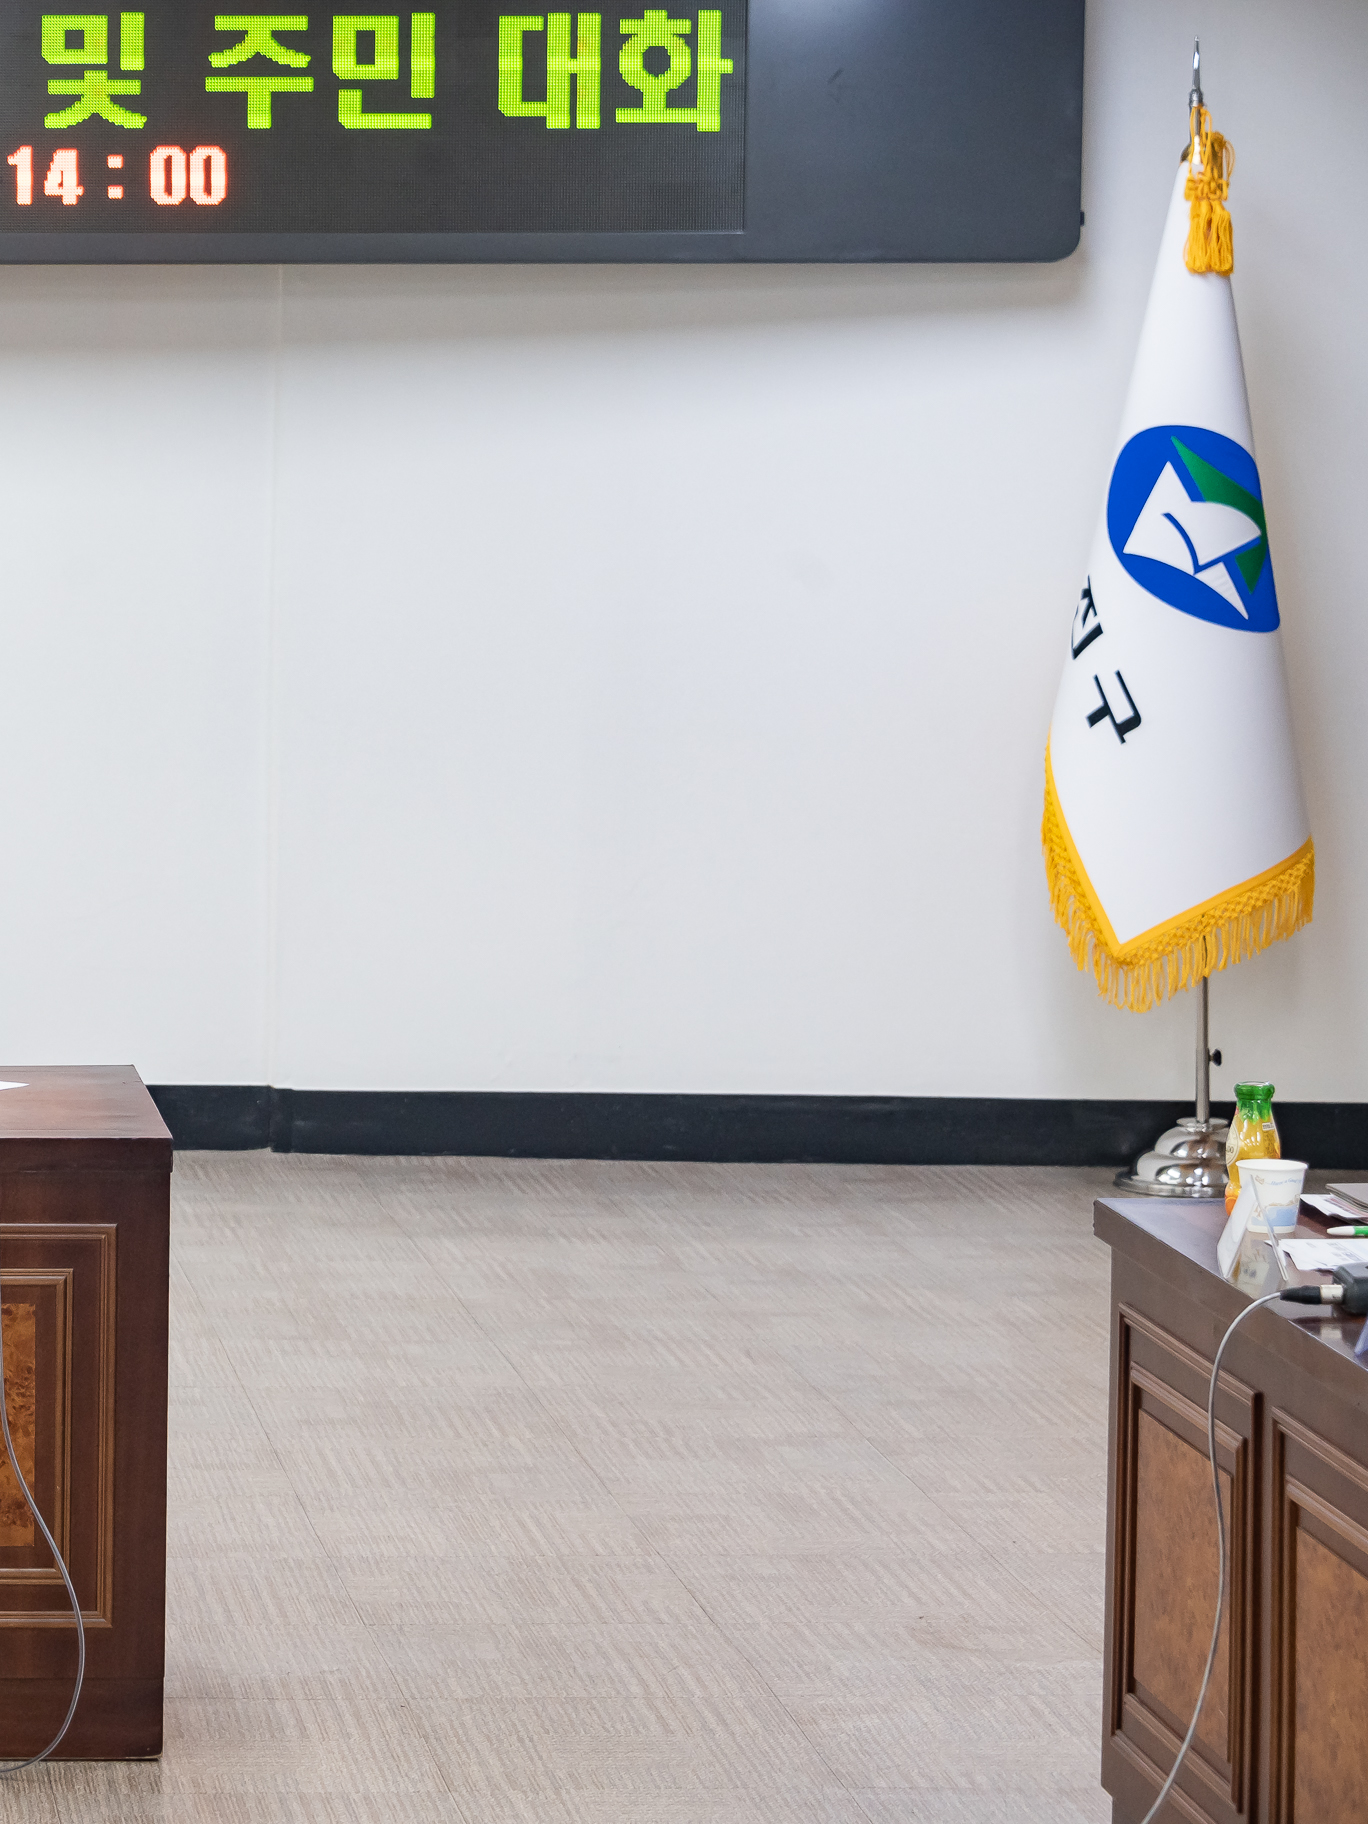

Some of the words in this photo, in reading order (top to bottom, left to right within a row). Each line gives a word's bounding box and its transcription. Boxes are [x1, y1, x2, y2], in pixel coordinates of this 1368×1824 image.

[41, 13, 149, 130] 및
[205, 12, 437, 131] 주민
[498, 10, 735, 133] 대화
